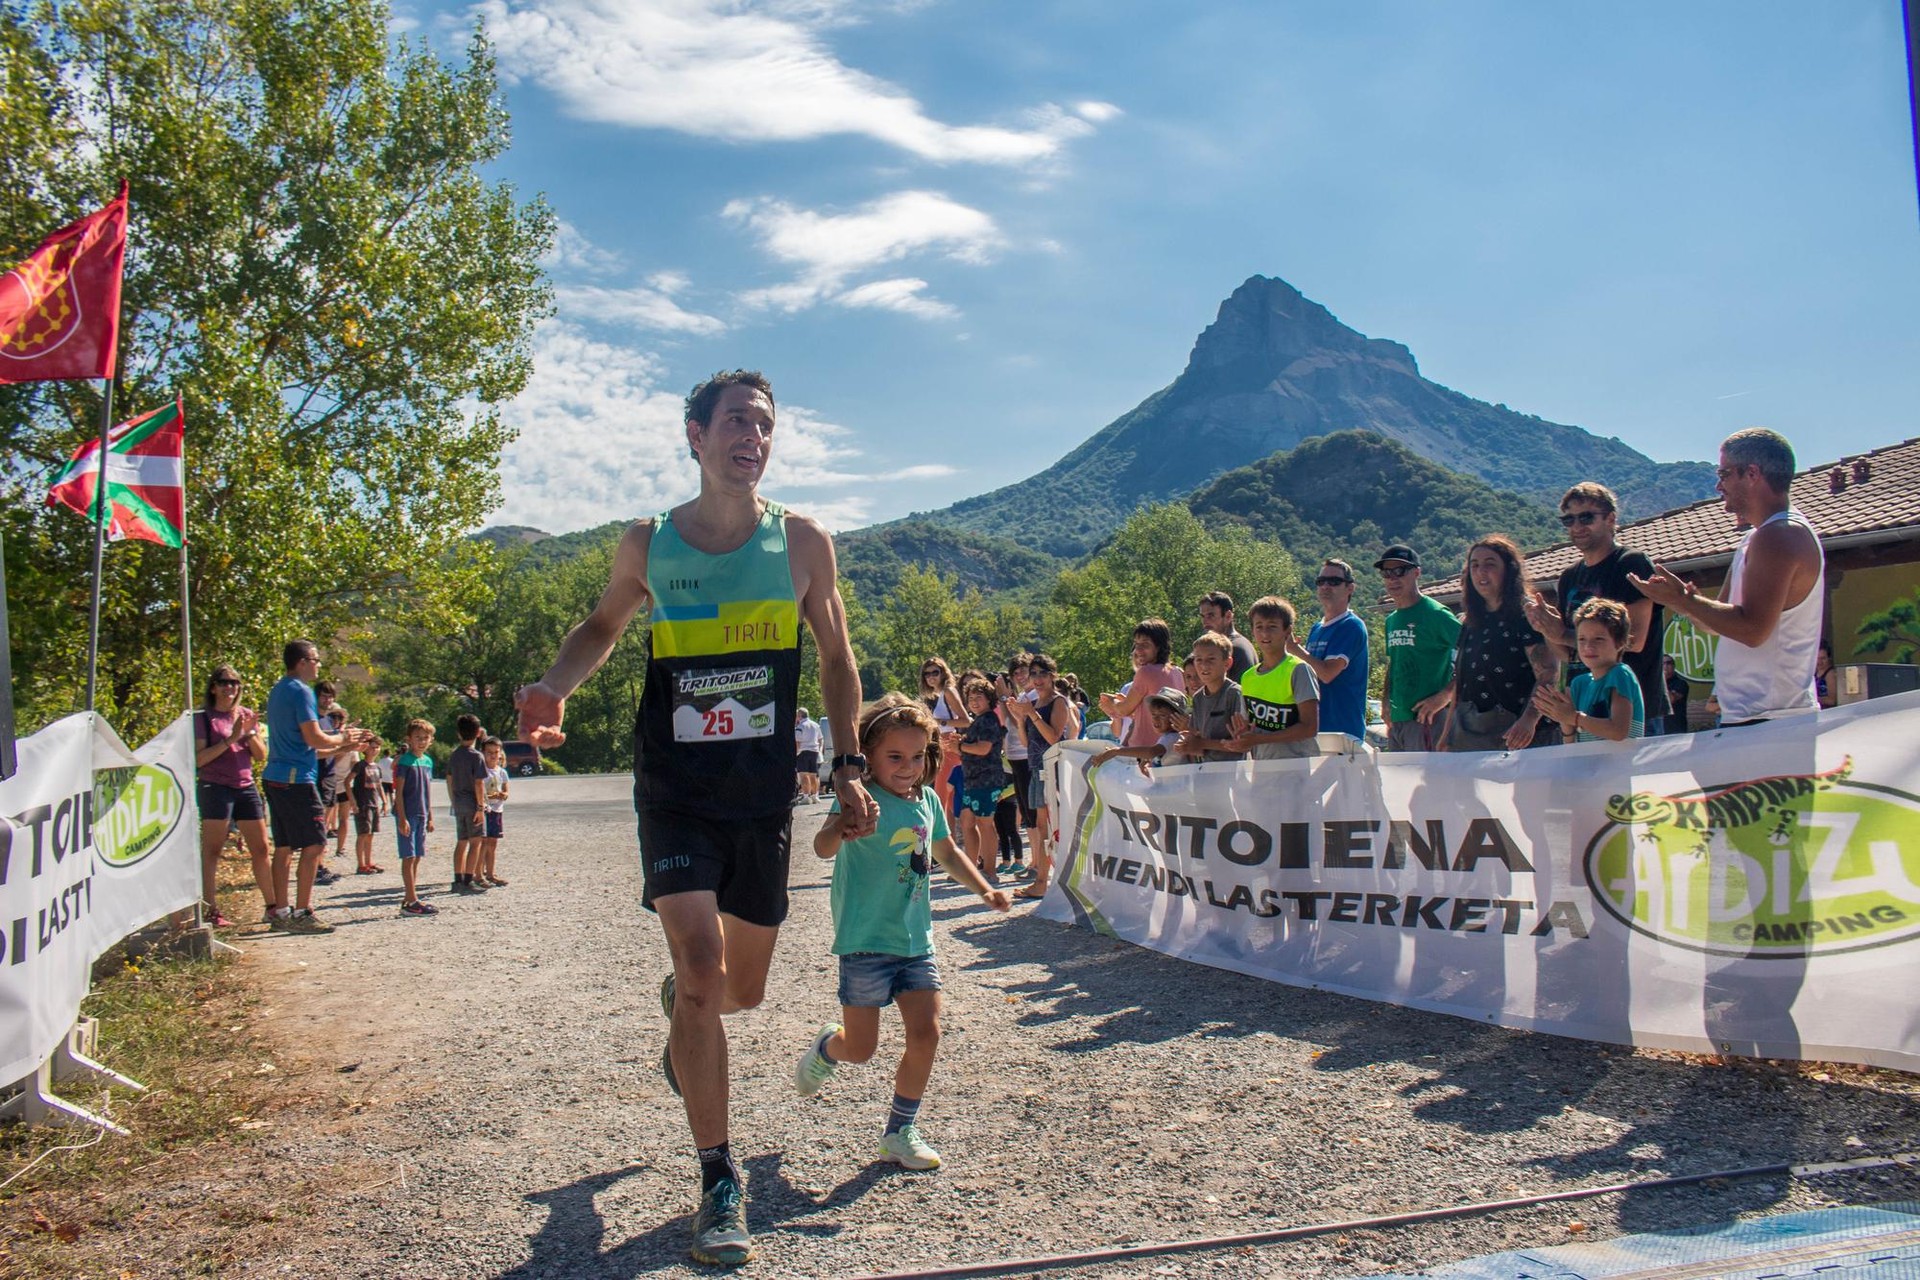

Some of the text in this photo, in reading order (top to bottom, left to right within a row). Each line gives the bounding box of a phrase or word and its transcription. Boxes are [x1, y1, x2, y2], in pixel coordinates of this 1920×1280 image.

[679, 666, 768, 693] TRITOIENA
[702, 709, 734, 736] 25
[124, 825, 162, 856] CAMPING
[1108, 804, 1536, 873] TRITOIENA
[653, 854, 690, 874] TIRITU
[1093, 853, 1590, 940] MENDI LASTERKETA
[1732, 904, 1908, 942] CAMPING
